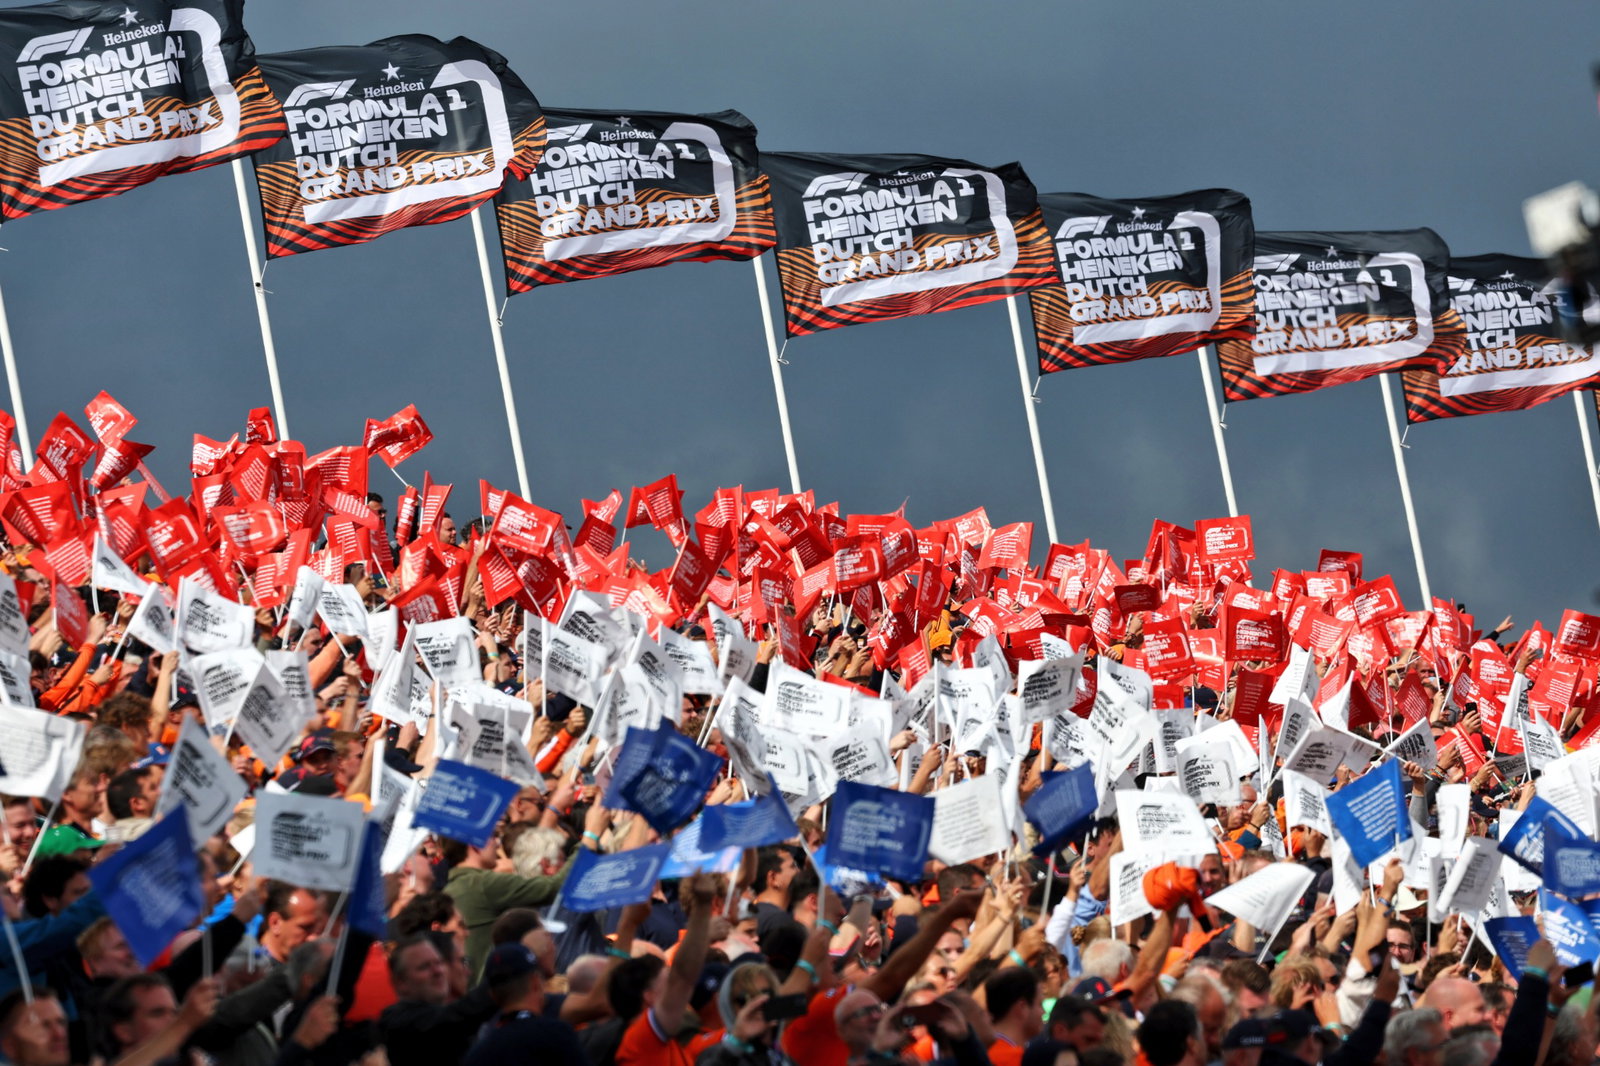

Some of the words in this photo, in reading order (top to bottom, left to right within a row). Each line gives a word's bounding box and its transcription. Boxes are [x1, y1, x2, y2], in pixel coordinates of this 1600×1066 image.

[103, 21, 166, 46] Heineken
[17, 36, 178, 90] FORMULA
[23, 60, 182, 114] HEINEKEN
[363, 80, 426, 98] Heineken
[29, 92, 145, 138] DUTCH
[284, 93, 446, 132] FORMULA
[446, 89, 468, 110] 1
[37, 115, 155, 161] GRAND
[290, 114, 448, 154] HEINEKEN
[600, 129, 657, 142] Heineken
[296, 142, 398, 178] DUTCH
[538, 142, 674, 170] ORMULA
[675, 143, 696, 160] 1
[300, 167, 407, 200] GRAND
[412, 152, 490, 180] PRIX
[530, 160, 676, 195] HEINEKEN
[879, 171, 936, 187] Heineken
[535, 181, 636, 217] DUTCH
[803, 180, 955, 222] FORMULA
[956, 177, 975, 197] 1
[540, 204, 643, 237] GRAND
[647, 197, 718, 223] PRIX
[807, 198, 958, 243] HEINEKEN
[812, 228, 914, 264] DUTCH
[818, 250, 921, 284] GRAND
[925, 235, 996, 267] PRIX
[1055, 232, 1178, 262] FORMULA
[1179, 231, 1195, 250] 1
[1060, 251, 1184, 283] HEINEKEN
[1252, 270, 1376, 292] ORMULA
[1380, 269, 1397, 287] 1
[1307, 259, 1361, 271] Heineken
[1065, 276, 1149, 303] DUTCH
[1069, 296, 1158, 322] GRAND
[1160, 290, 1212, 312] PRIX
[1251, 327, 1345, 354] GRAND
[1348, 320, 1414, 345] PRIX
[1466, 328, 1517, 351] TCH
[1446, 348, 1522, 374] RAND
